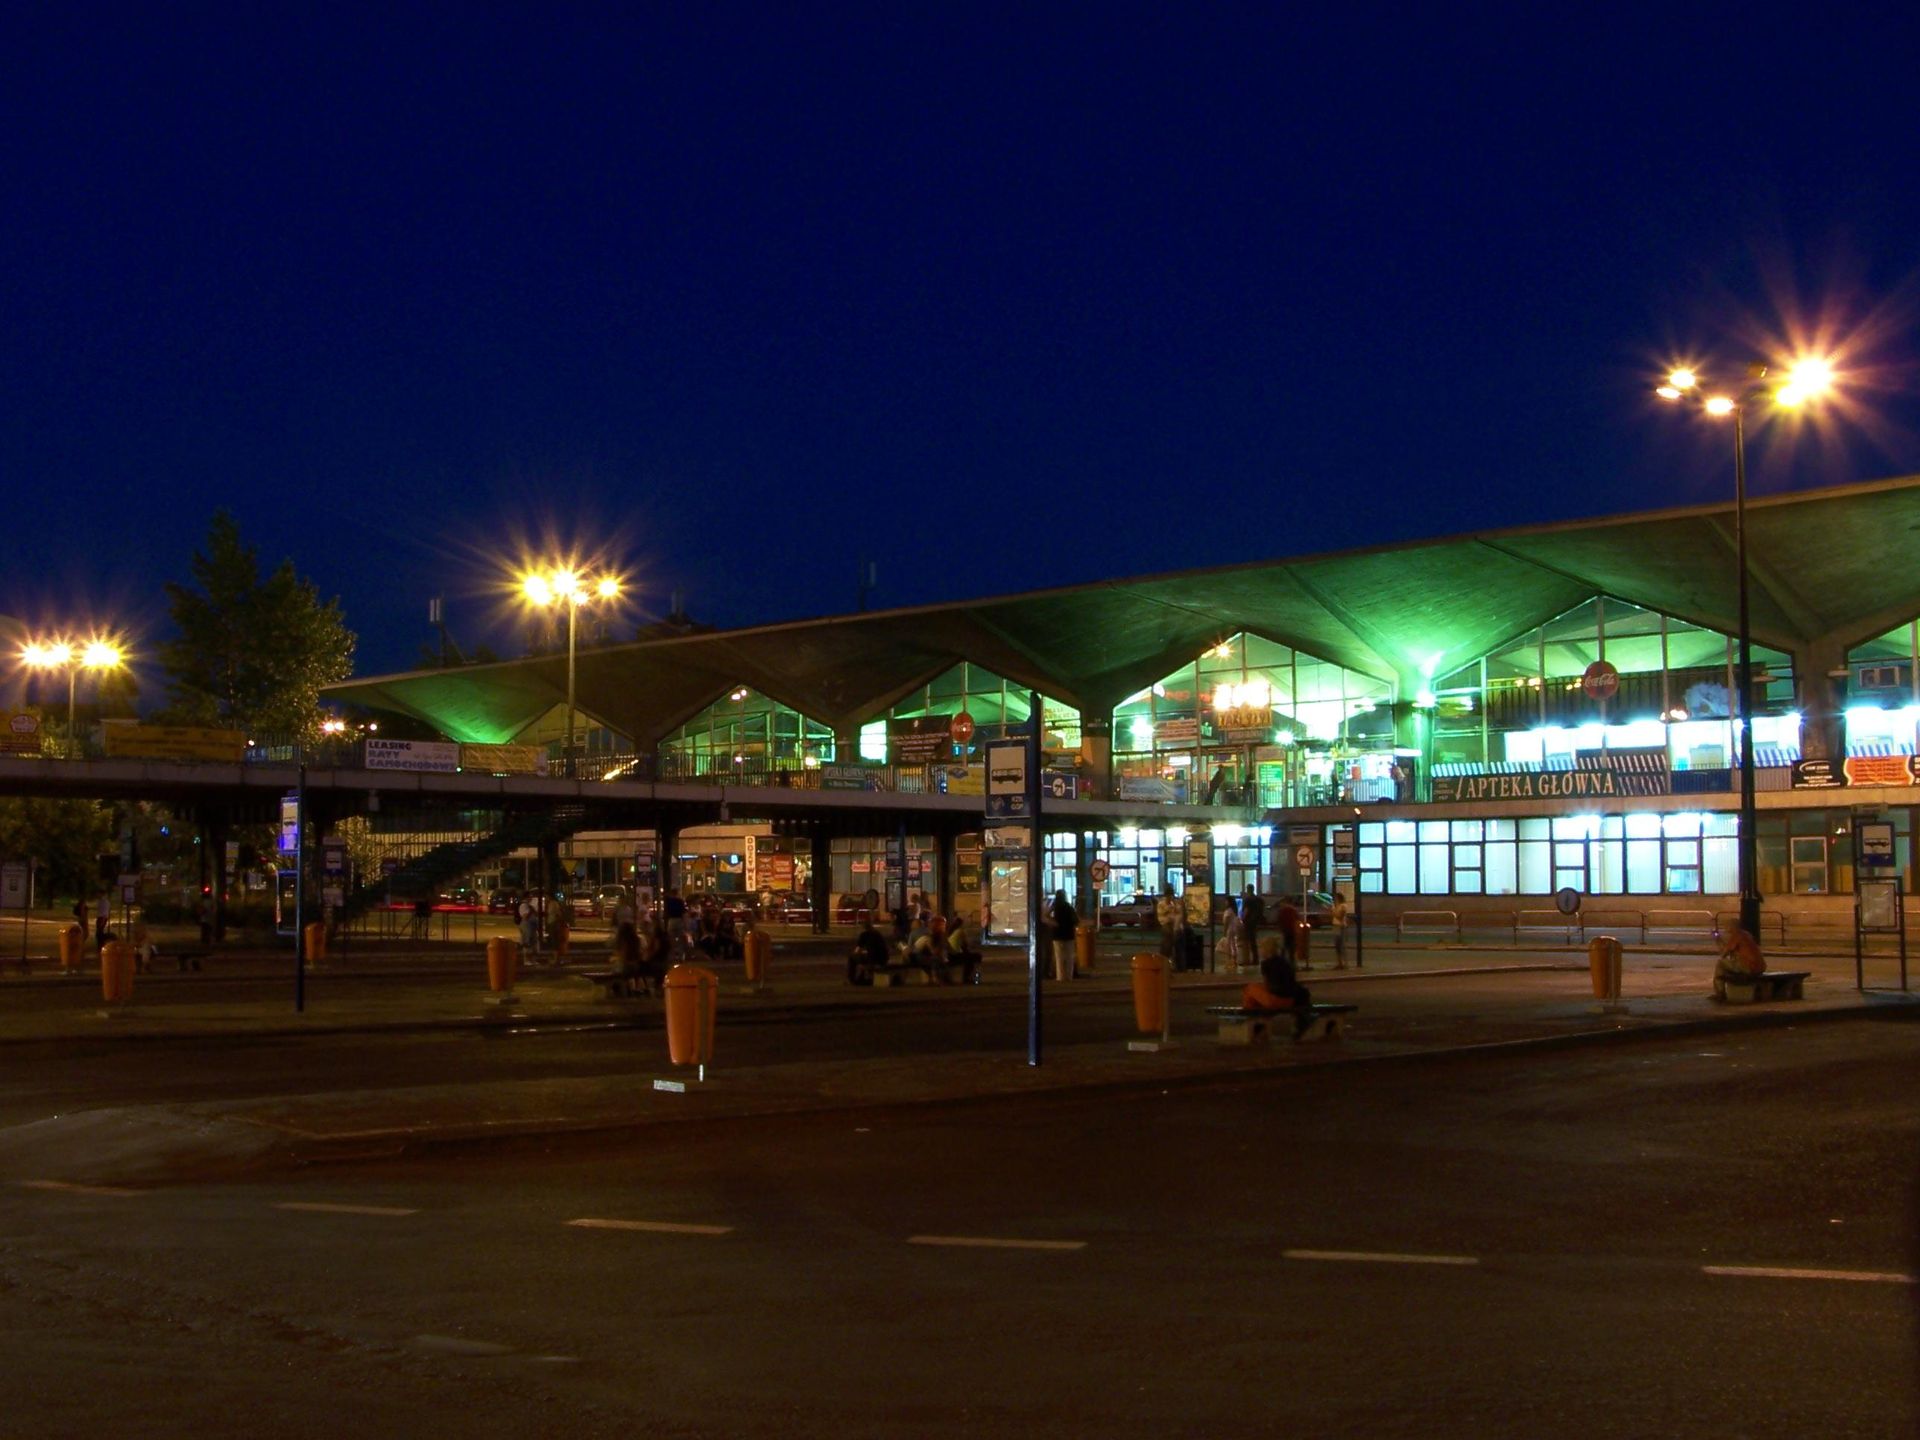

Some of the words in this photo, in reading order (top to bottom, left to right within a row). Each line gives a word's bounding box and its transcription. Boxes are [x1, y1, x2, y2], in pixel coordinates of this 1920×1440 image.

[368, 741, 412, 751] LEASING
[368, 751, 400, 760] RATY
[1466, 775, 1534, 798] APTEKA
[1538, 771, 1615, 796] GŁÓWNA
